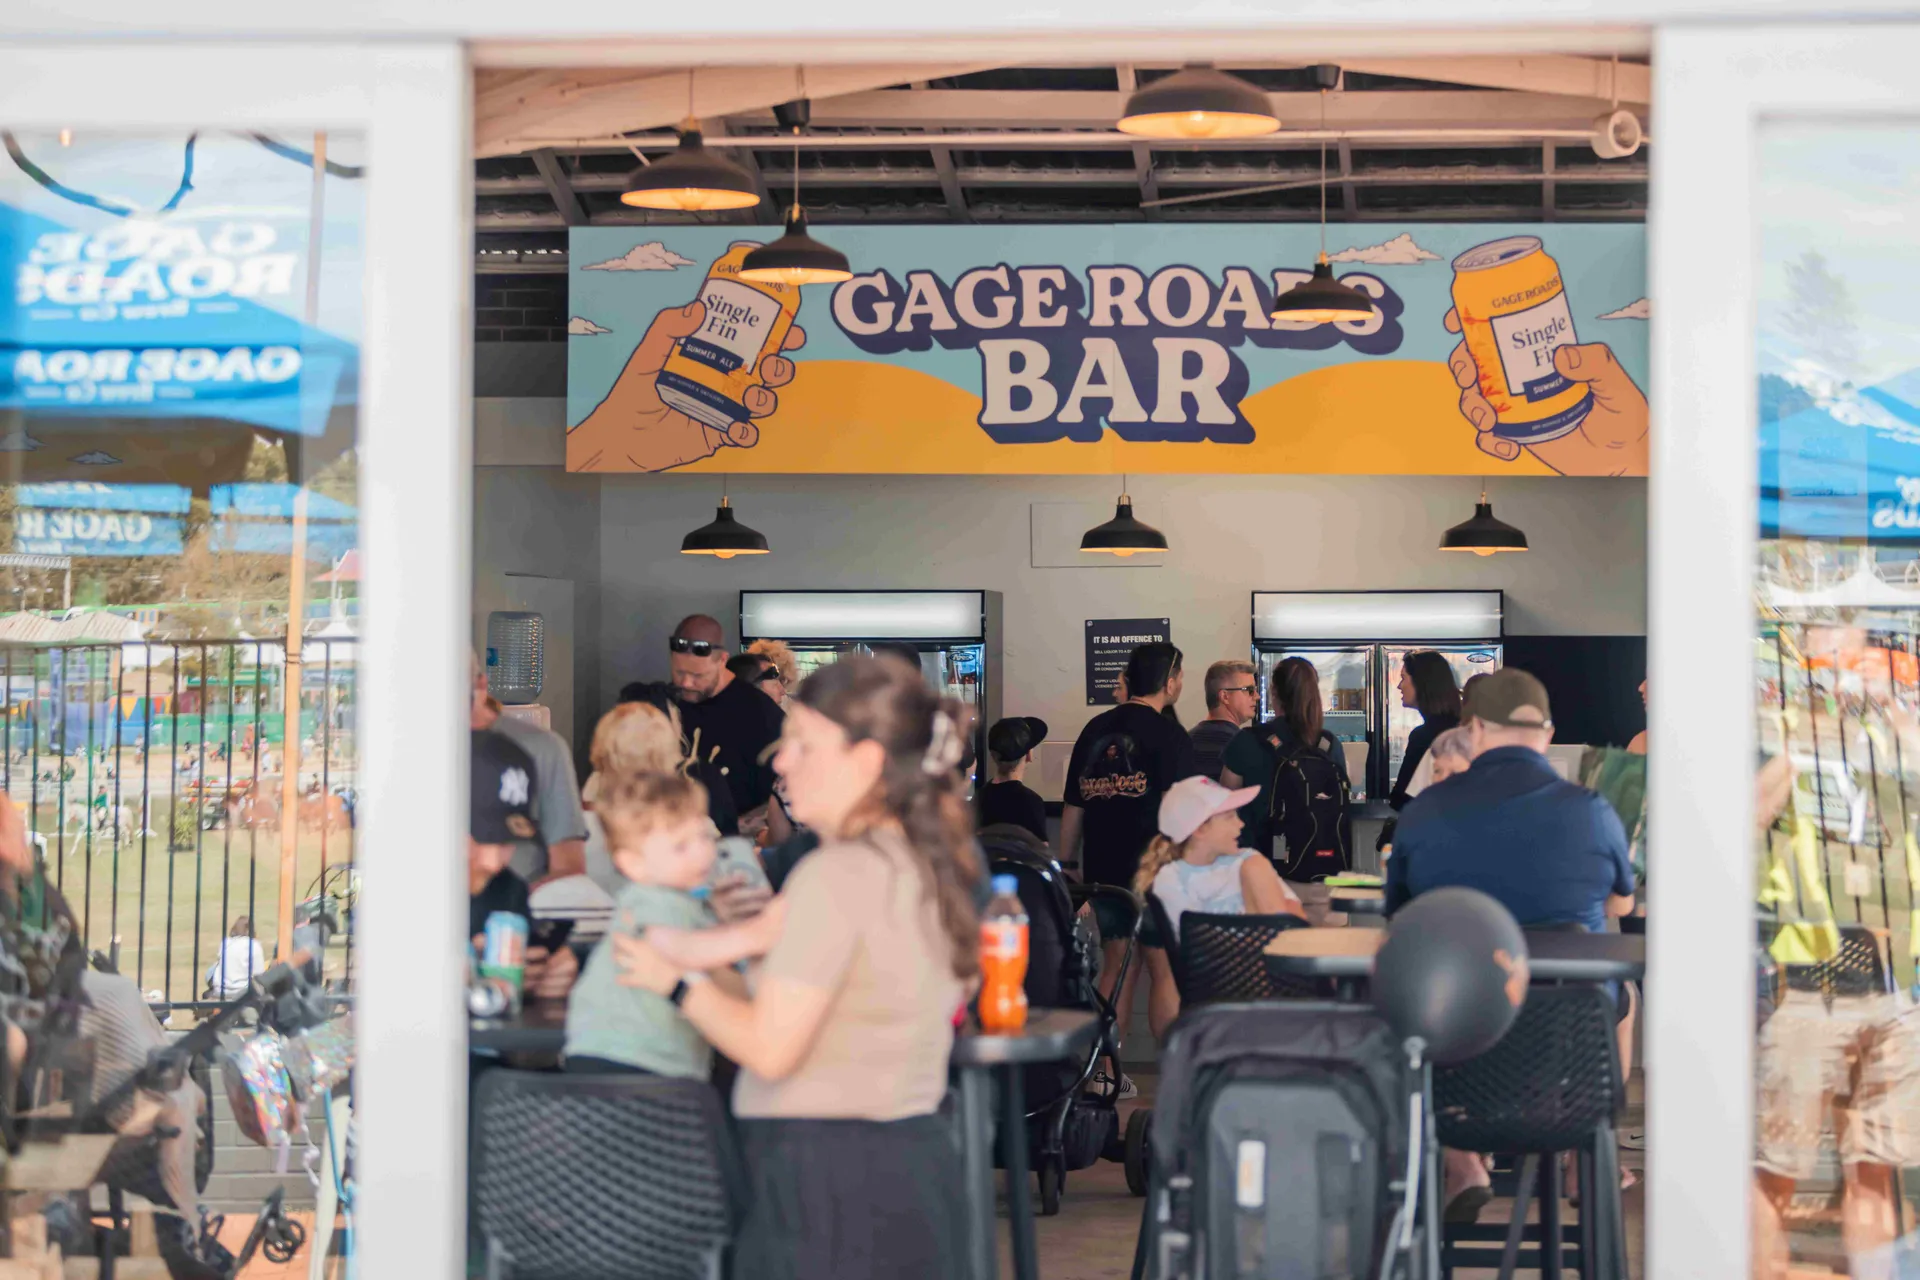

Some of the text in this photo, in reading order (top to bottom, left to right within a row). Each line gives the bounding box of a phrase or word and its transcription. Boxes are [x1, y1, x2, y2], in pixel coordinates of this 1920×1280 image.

[706, 293, 760, 328] Single
[831, 263, 1082, 340] GAGE
[705, 315, 738, 342] Fin
[1511, 315, 1568, 350] Single
[685, 343, 736, 369] SUMMER ALE
[1532, 345, 1556, 367] Fi
[982, 336, 1242, 428] BAR
[1532, 378, 1564, 395] SUMMER
[1093, 634, 1163, 644] IT IS AN OFFENCE TO
